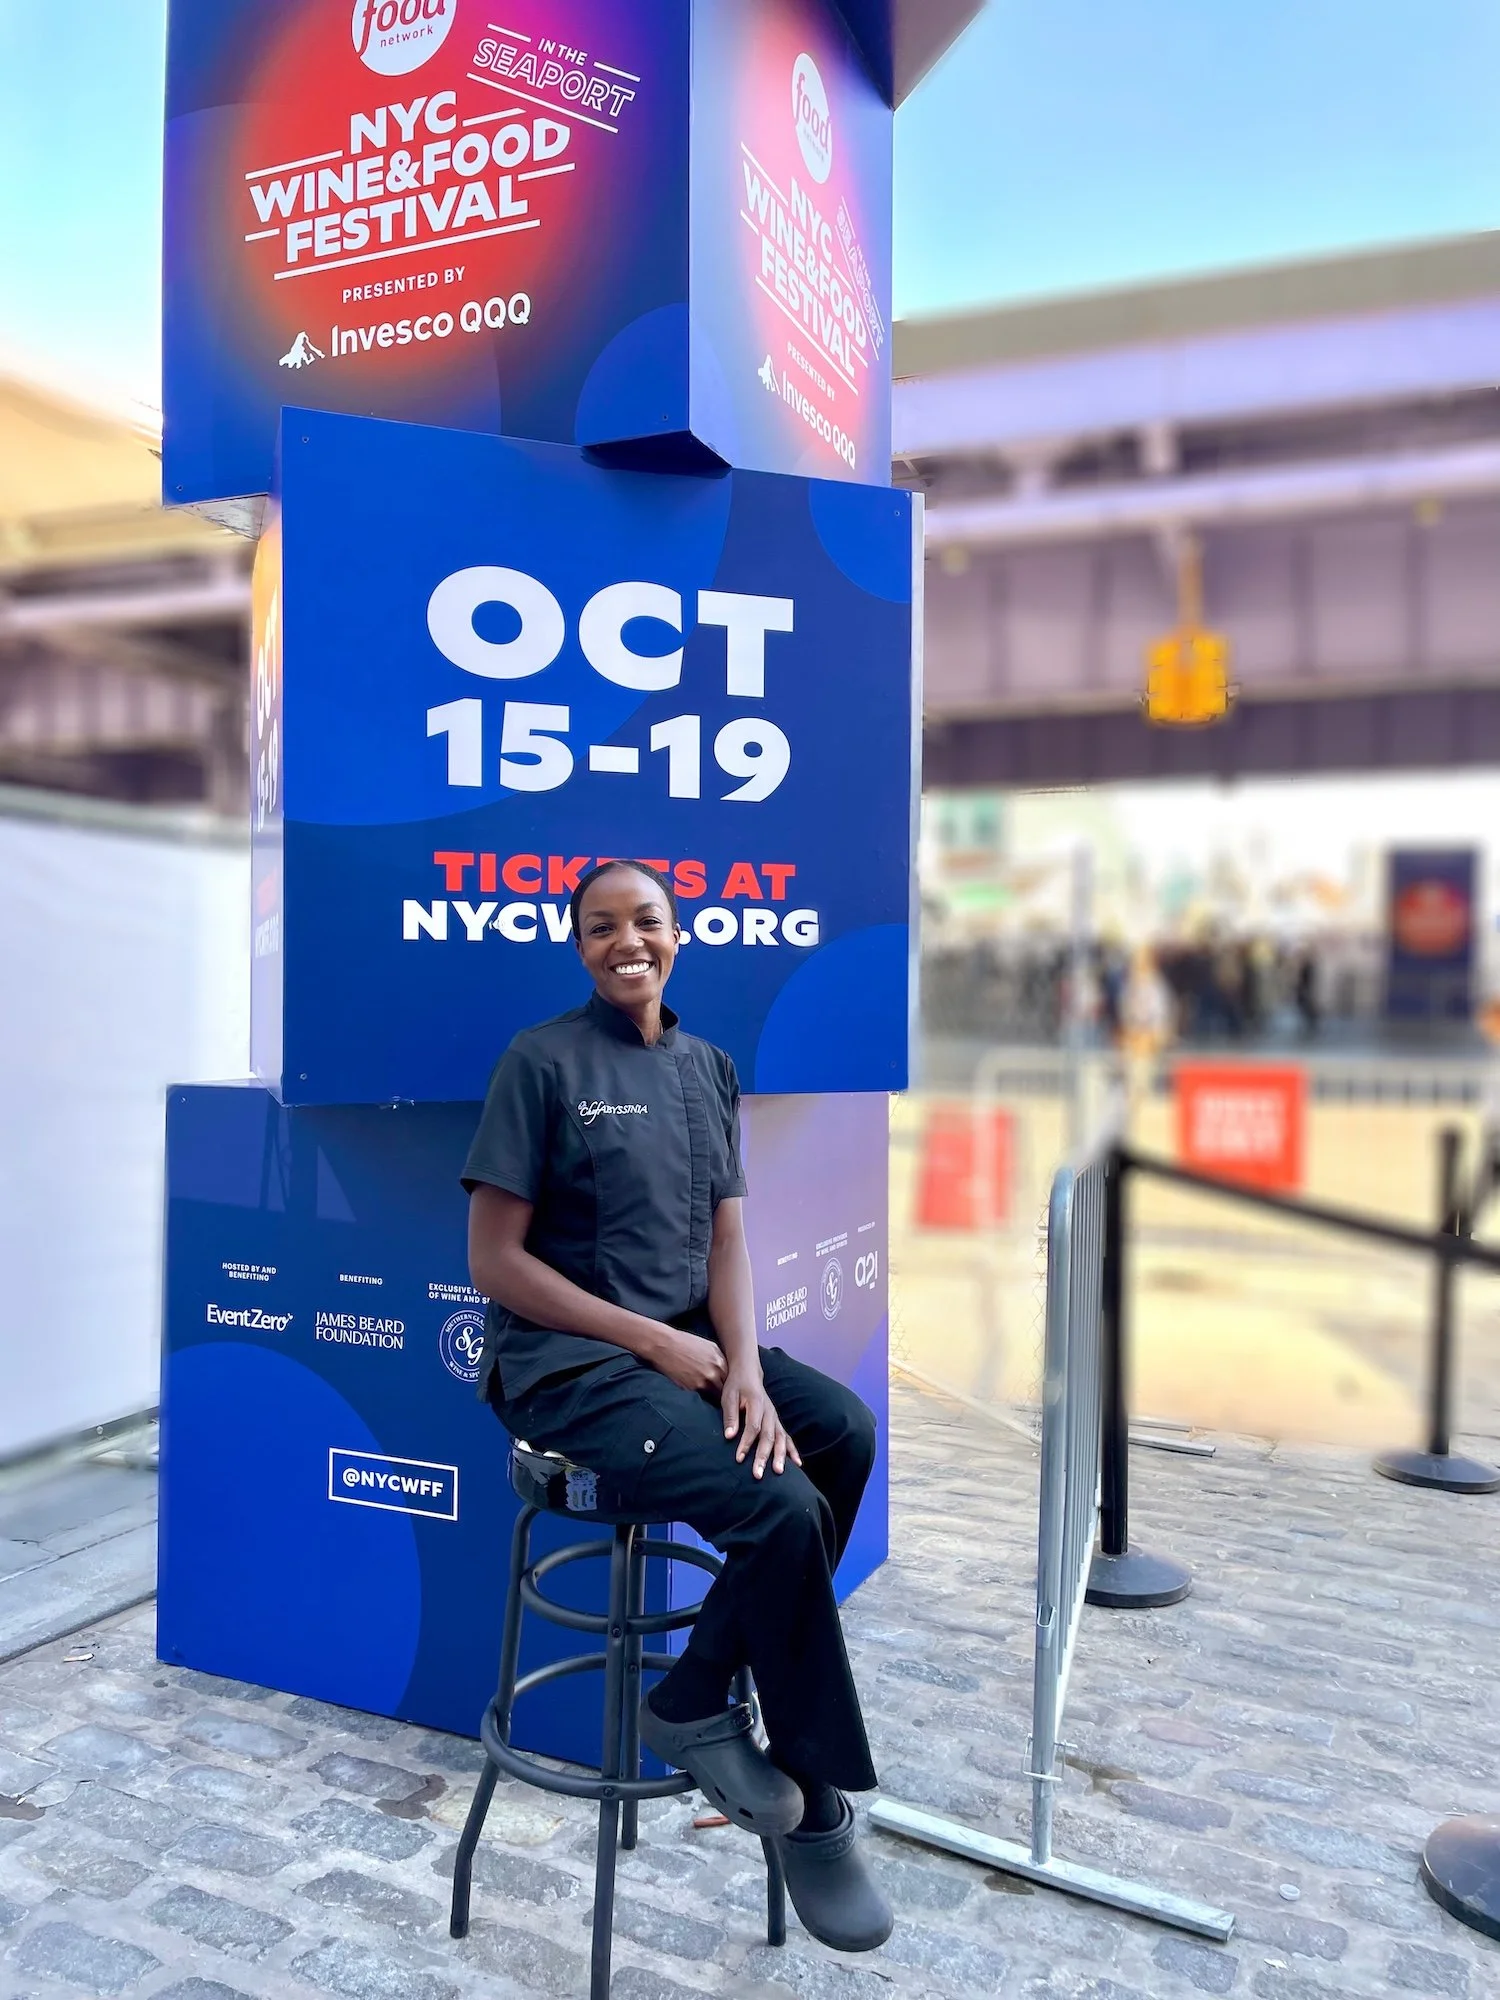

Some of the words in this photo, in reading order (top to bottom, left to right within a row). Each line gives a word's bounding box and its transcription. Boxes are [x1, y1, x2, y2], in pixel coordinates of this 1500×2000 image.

[380, 24, 434, 48] network
[537, 38, 556, 55] IN
[557, 43, 588, 66] THE
[472, 38, 636, 118] SEAPORT
[351, 90, 457, 155] NYC
[796, 72, 829, 154] food
[249, 117, 571, 223] WINE&FOOD
[286, 174, 528, 263] FESTIVAL
[791, 176, 833, 263] NYC
[743, 160, 867, 348] WINE&FOOD
[342, 272, 438, 304] PRESENTED
[444, 266, 466, 284] BY
[762, 233, 855, 379] FESTIVAL
[331, 312, 454, 357] Invesco
[459, 292, 532, 334] QQQ
[787, 341, 826, 392] PRESENTED
[783, 370, 831, 443] Invesco
[832, 424, 856, 470] QQQ
[427, 565, 794, 697] OCT
[257, 584, 278, 740] OCT
[427, 698, 791, 802] 15-19
[433, 851, 706, 899] TICKS
[721, 862, 796, 900] AT
[222, 1262, 250, 1272] HOSTED
[251, 1265, 260, 1273] BY
[261, 1266, 277, 1275] AND
[228, 1271, 270, 1281] BENEFITING
[339, 1274, 383, 1285] BENEFITING
[428, 1283, 473, 1294] EXCLUSIVE
[207, 1303, 291, 1331] EventZero
[428, 1291, 439, 1299] OF
[441, 1293, 462, 1302] WINE
[463, 1295, 480, 1304] AND
[766, 1295, 786, 1319] JAMES
[786, 1286, 807, 1307] BEARD
[766, 1300, 808, 1331] FOUNDATION
[315, 1311, 356, 1329] JAMES
[359, 1316, 405, 1334] BEARD
[316, 1326, 404, 1350] FOUNDATION
[445, 1314, 472, 1333] SOUTHERN
[342, 1467, 444, 1498] @NYCWFF
